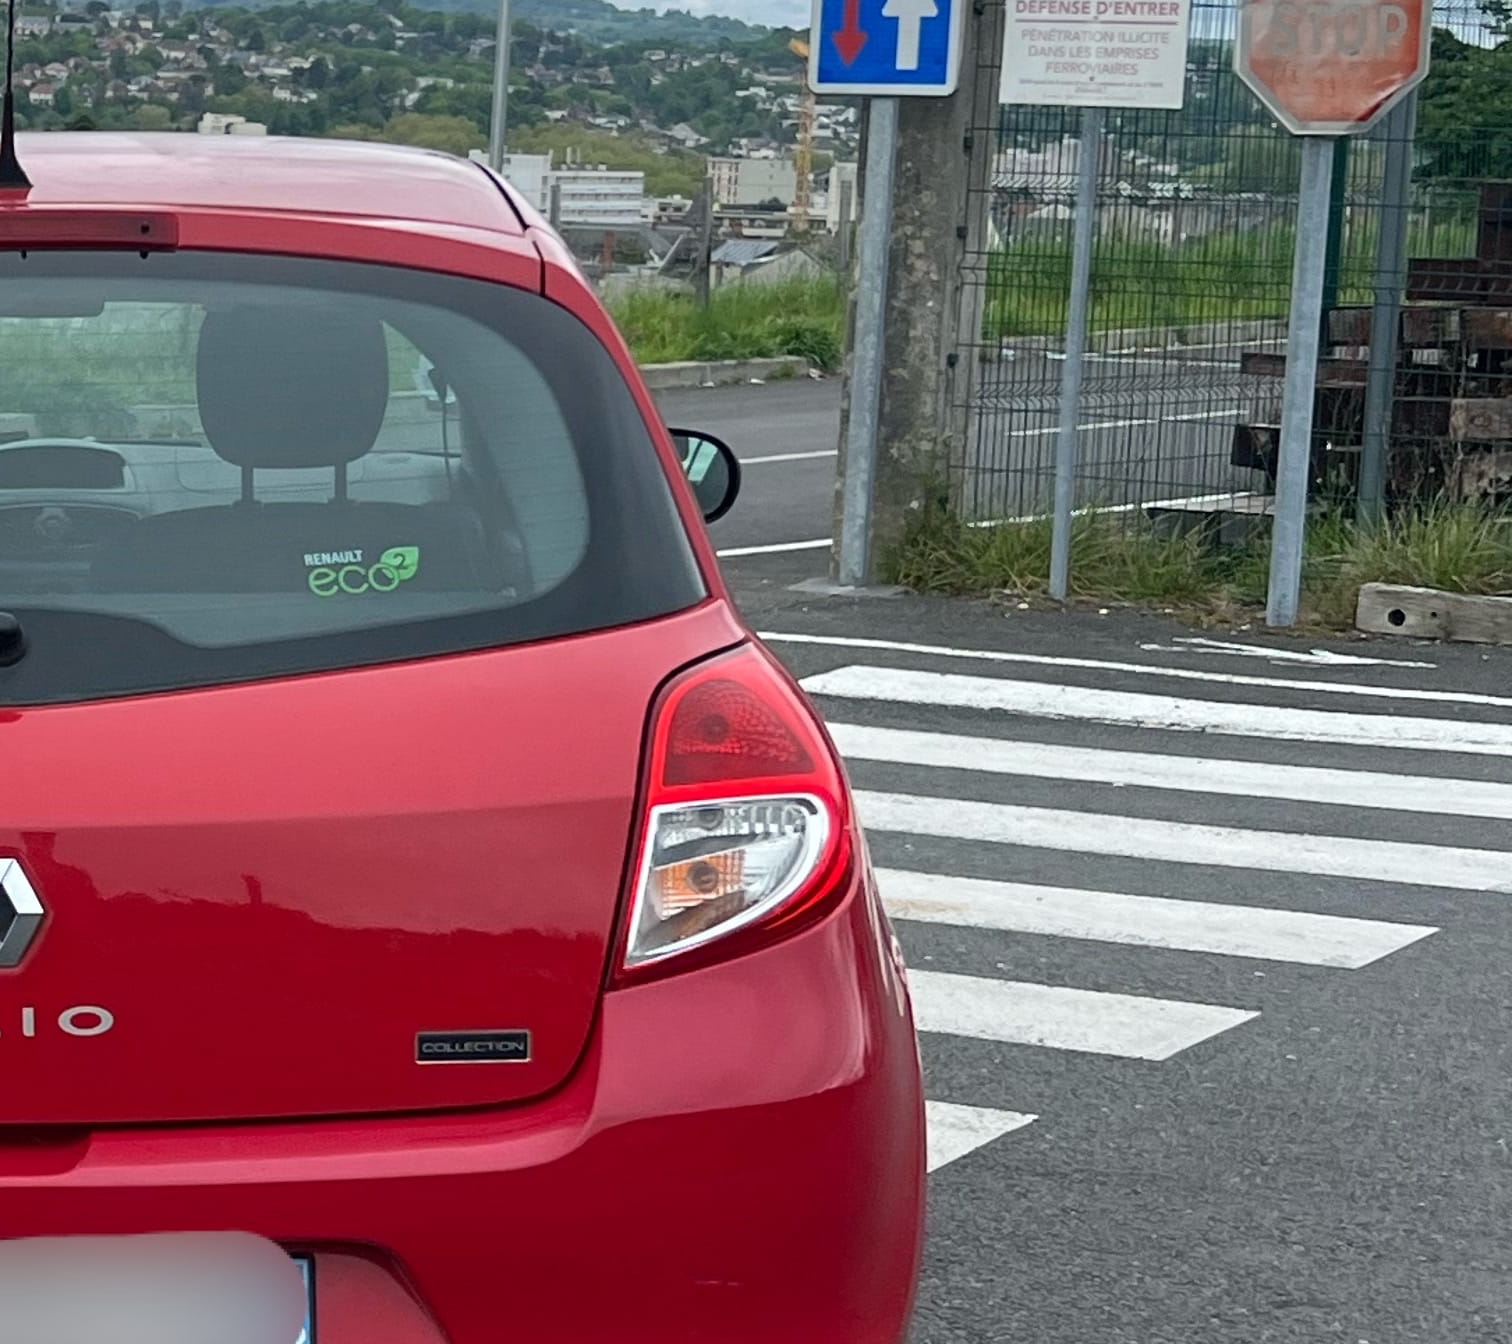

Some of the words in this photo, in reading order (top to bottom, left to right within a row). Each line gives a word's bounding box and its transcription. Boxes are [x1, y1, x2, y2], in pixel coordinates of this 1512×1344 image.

[1015, 0, 1091, 15] DÉFENSE
[1096, 1, 1180, 17] D'ENTRER
[1021, 28, 1114, 44] PÉNÉTRATION
[1118, 31, 1170, 45] ILLICITE
[1271, 3, 1408, 56] STOP
[1028, 45, 1065, 58] DANS
[1069, 46, 1092, 58] LES
[1095, 47, 1159, 61] EMPRISES
[1045, 61, 1139, 76] FERROVIAIRES
[304, 549, 363, 567] RENAULT
[422, 1041, 525, 1054] COLLECTION
